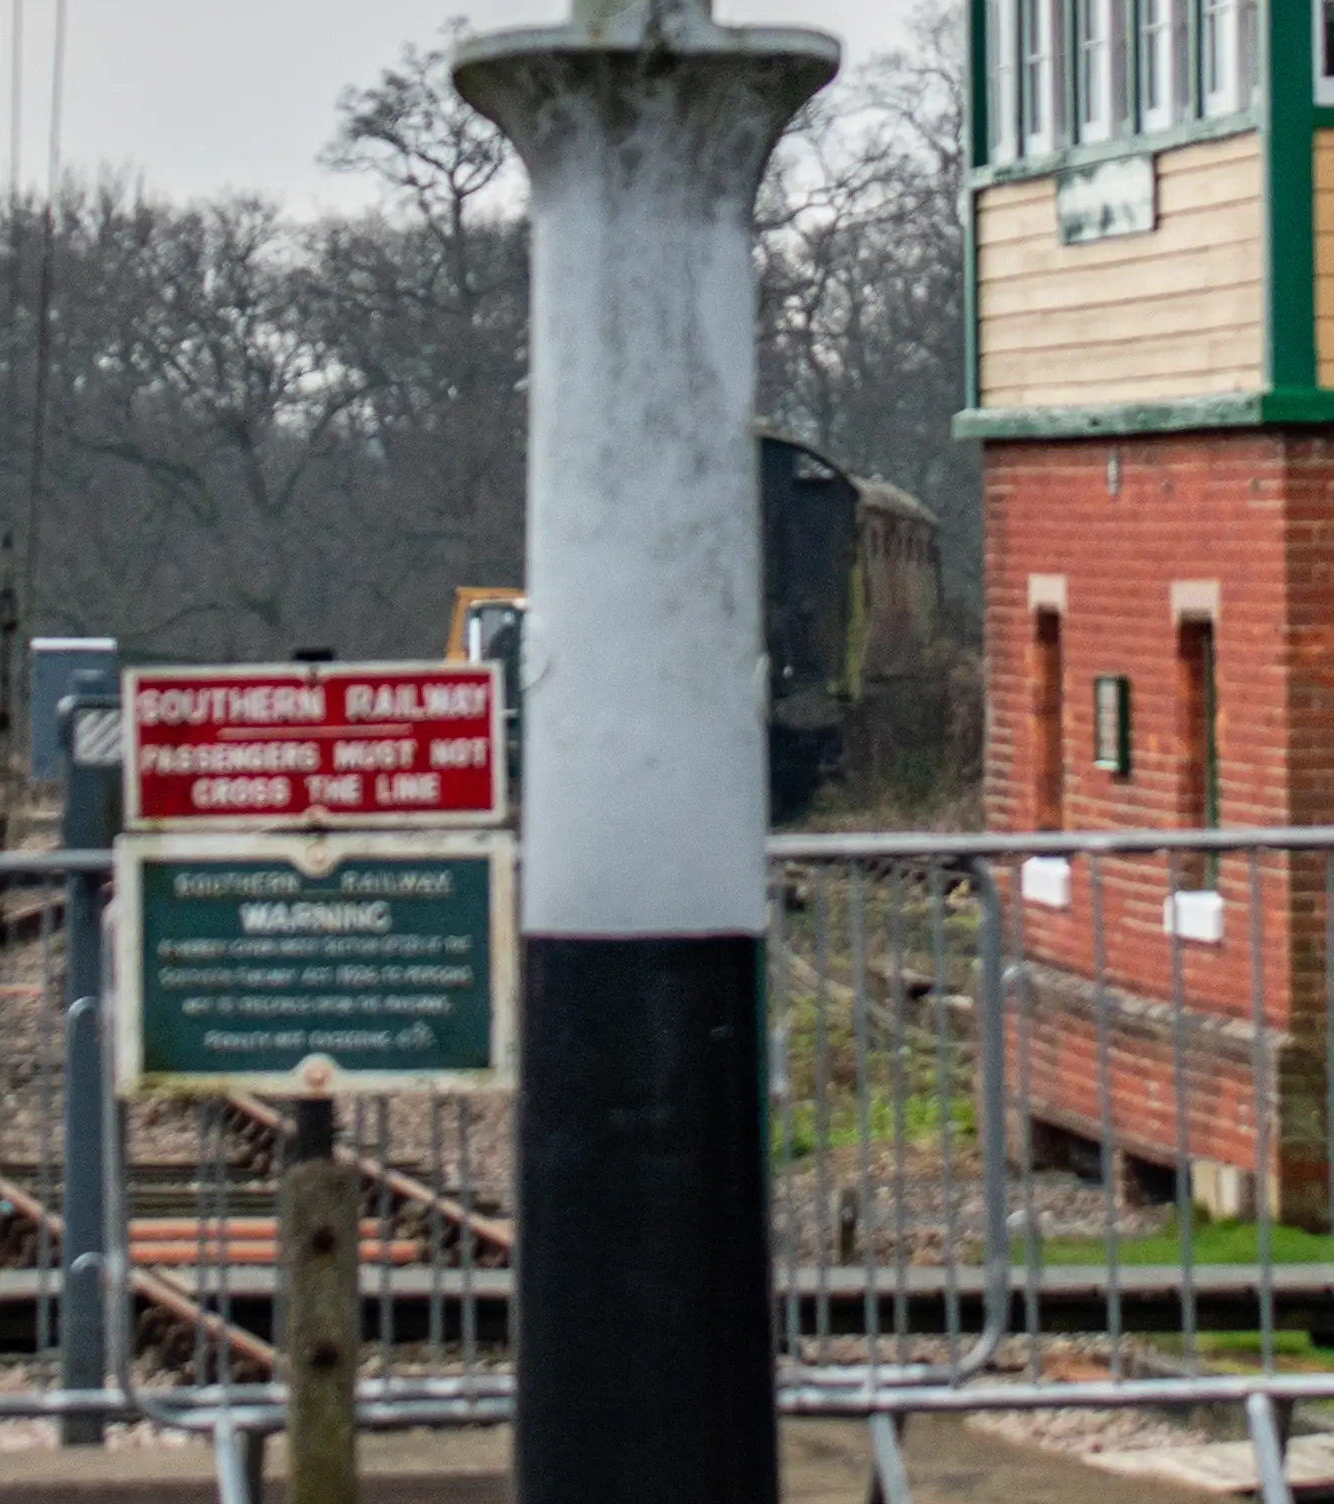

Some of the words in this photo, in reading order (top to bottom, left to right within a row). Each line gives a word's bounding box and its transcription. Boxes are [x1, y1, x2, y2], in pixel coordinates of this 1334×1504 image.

[137, 688, 325, 724] SOUTHERN
[345, 684, 487, 721] RAILWAY
[141, 743, 319, 774] PASSENGERS
[334, 740, 415, 771] MUST
[430, 738, 487, 768] NOT
[193, 777, 290, 808] CROSS
[305, 775, 362, 806] THE
[375, 773, 439, 805] LINE
[240, 901, 392, 933] WARNING
